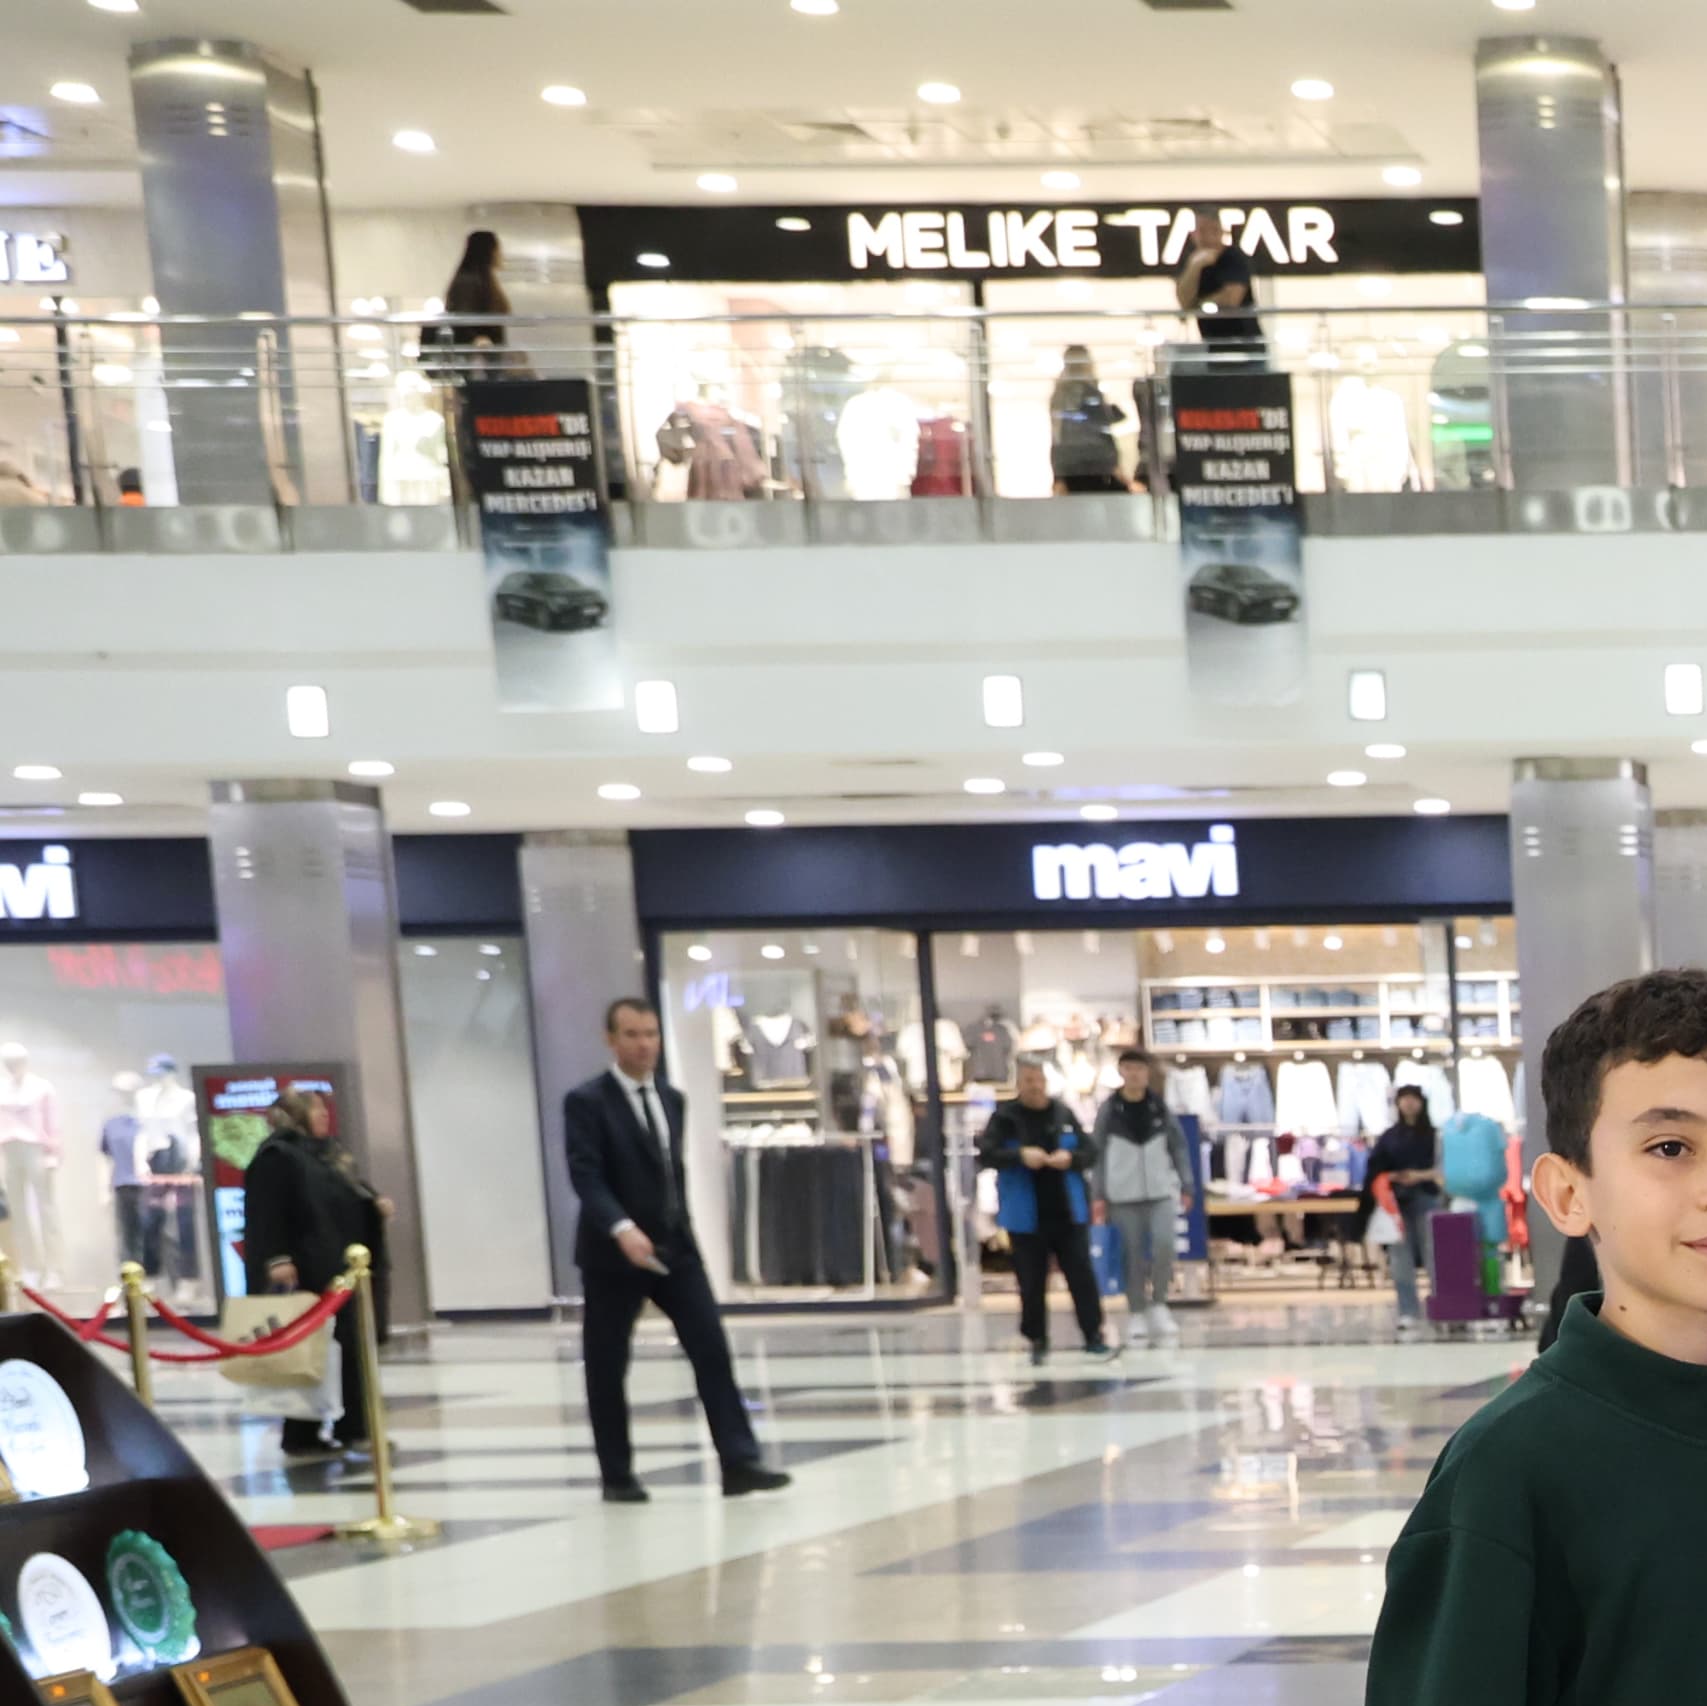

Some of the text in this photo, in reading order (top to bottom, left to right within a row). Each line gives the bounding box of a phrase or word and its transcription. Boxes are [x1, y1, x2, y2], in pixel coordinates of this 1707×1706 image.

[847, 209, 1101, 269] MELIKE
[504, 465, 575, 487] KAZAN
[1202, 460, 1270, 480] KAZAN
[0, 845, 76, 919] vi
[1032, 824, 1239, 900] mavi
